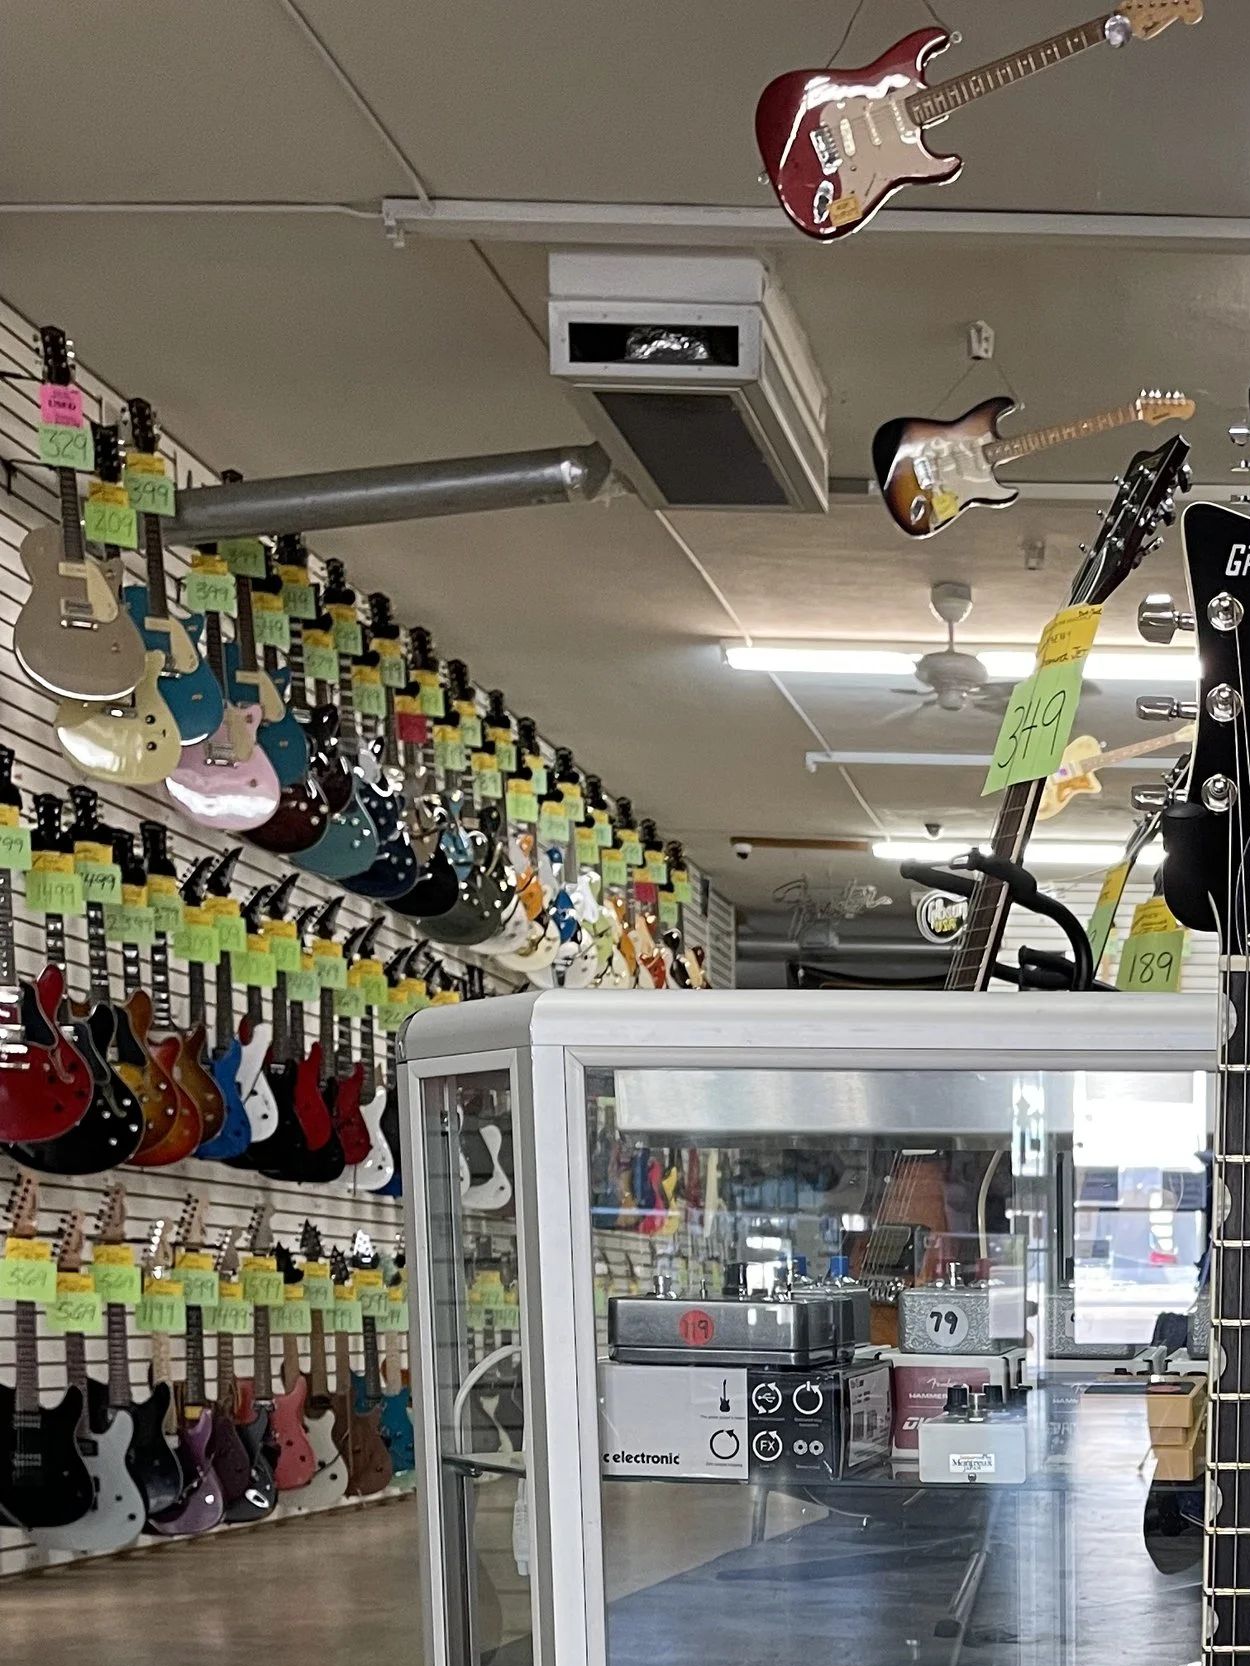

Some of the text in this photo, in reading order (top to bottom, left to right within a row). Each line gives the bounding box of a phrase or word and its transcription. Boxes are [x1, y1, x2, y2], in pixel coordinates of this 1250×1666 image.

[49, 428, 87, 467] 329
[998, 690, 1065, 768] 349
[1128, 951, 1174, 984] 189
[683, 1319, 710, 1340] 119
[929, 1310, 959, 1335] 79
[612, 1451, 681, 1465] electronic
[760, 1440, 776, 1452] FX
